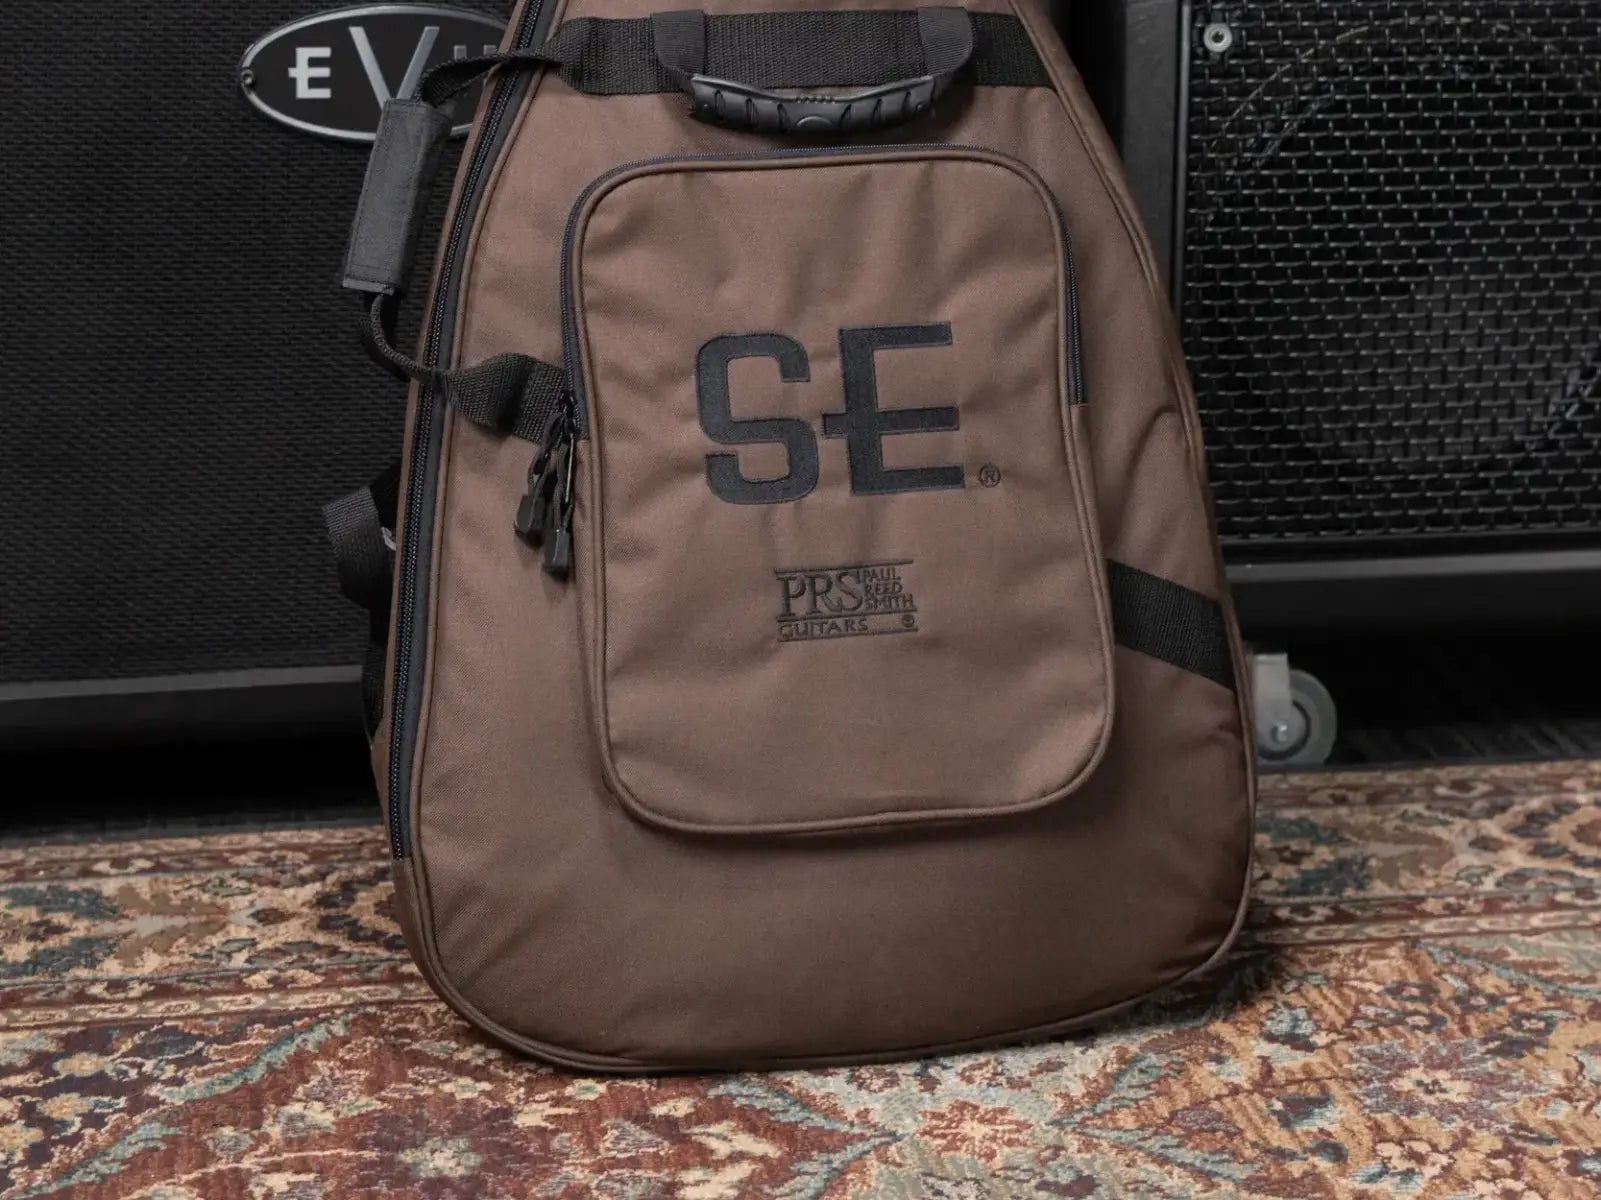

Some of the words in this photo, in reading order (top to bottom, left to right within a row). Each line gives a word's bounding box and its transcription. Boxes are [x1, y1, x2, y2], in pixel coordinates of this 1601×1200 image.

[288, 26, 497, 112] EV
[695, 322, 966, 506] SE
[862, 567, 901, 583] PAUL
[776, 569, 863, 618] PRS
[864, 581, 903, 596] REED
[864, 593, 914, 611] SMITH
[779, 618, 868, 639] GUITARS
